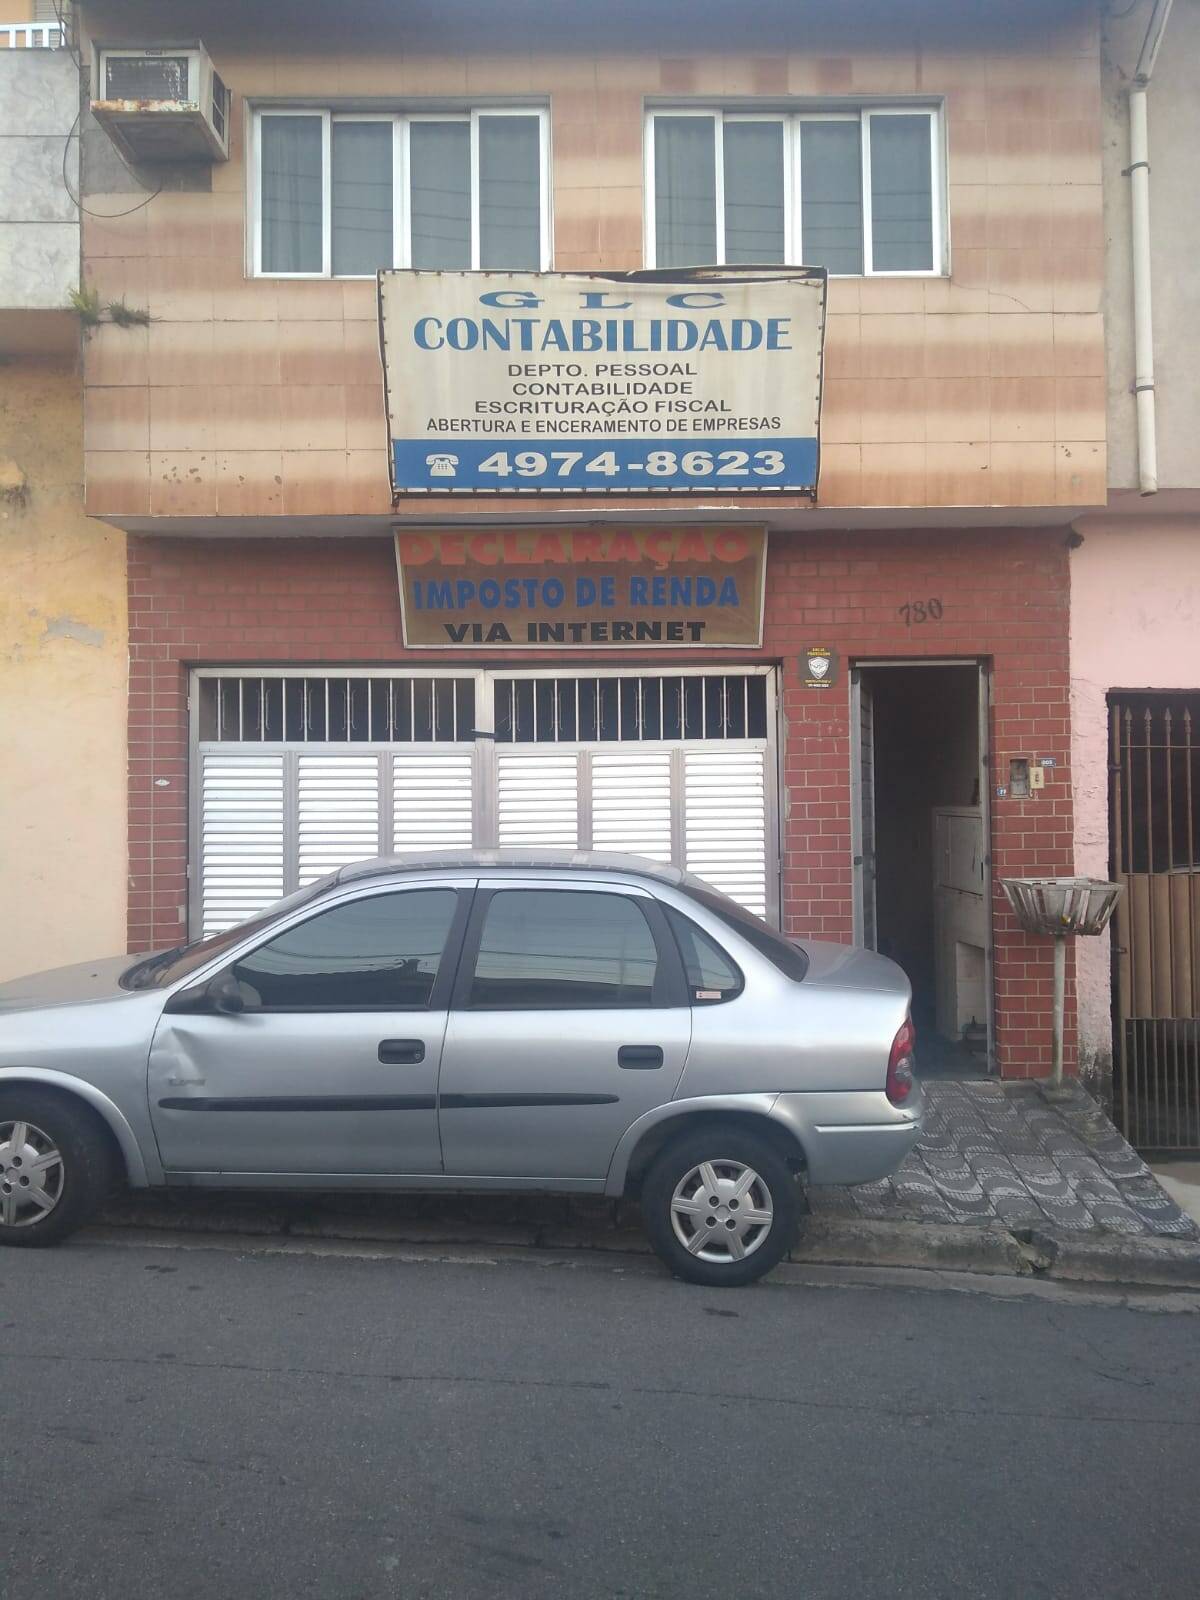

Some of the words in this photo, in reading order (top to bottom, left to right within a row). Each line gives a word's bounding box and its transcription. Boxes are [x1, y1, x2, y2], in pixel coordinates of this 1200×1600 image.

[414, 317, 792, 351] CONTABILIDADE
[508, 364, 589, 378] DEPTO.
[595, 362, 698, 376] PESSOAL
[512, 381, 693, 396] CONTABILIDADE
[475, 398, 648, 417] ESCRITURAÇÃO
[655, 400, 732, 413] FISCAL
[426, 418, 517, 433] ABERTURA
[521, 419, 532, 432] E
[536, 418, 662, 433] ENCERAMENTO
[666, 418, 688, 432] DE
[692, 416, 782, 431] EMPRESAS
[478, 450, 785, 477] 4974-8623
[413, 577, 565, 609] IMPOSTO
[575, 576, 616, 608] DE
[629, 575, 740, 608] RENDA
[444, 622, 512, 643] VIA
[527, 620, 706, 642] INTERNET
